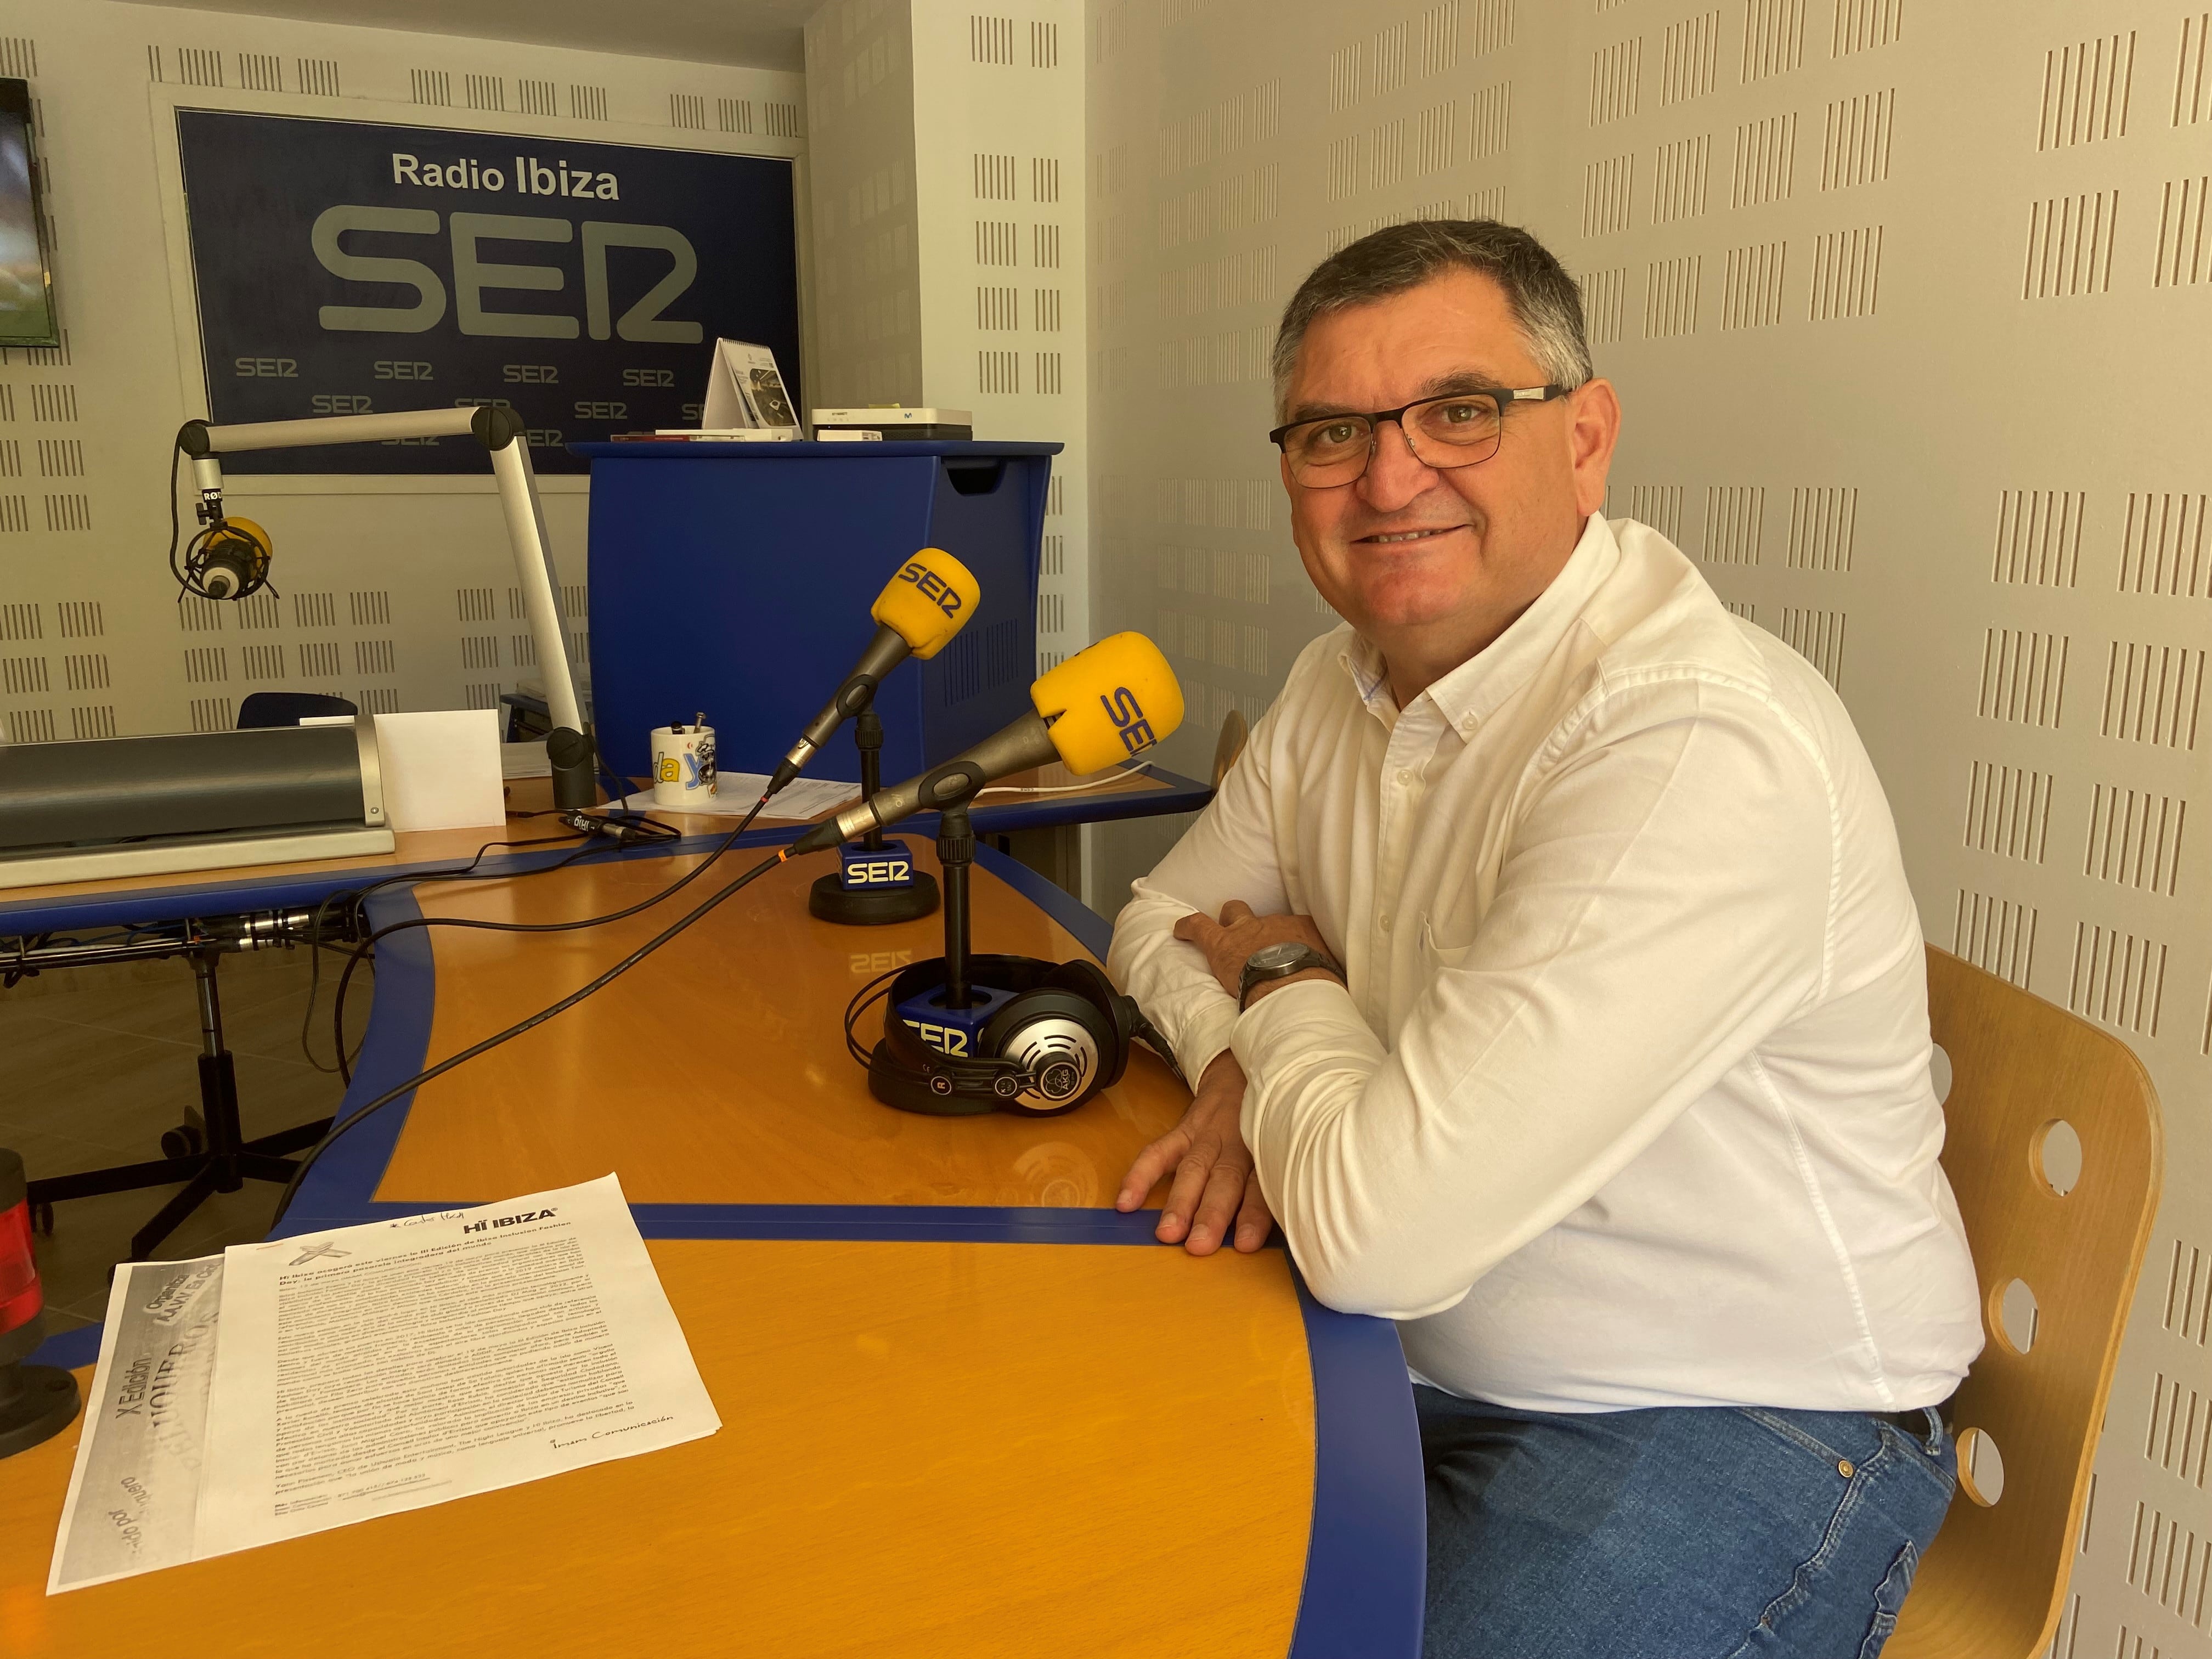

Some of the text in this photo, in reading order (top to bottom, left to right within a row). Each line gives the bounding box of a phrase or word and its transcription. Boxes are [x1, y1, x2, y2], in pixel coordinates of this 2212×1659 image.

[392, 153, 620, 200] Radio Ibiza
[311, 205, 703, 344] SER
[235, 357, 299, 378] SER
[373, 360, 434, 381] SER
[503, 364, 559, 384] SER
[623, 369, 675, 387] SER
[312, 394, 374, 414] SER
[574, 401, 628, 420] SER
[525, 429, 564, 447] ER
[898, 563, 962, 619] SER
[1100, 686, 1158, 758] SE
[848, 861, 910, 884] SER
[119, 1357, 152, 1406] Edición
[592, 1415, 674, 1439] Comunicación
